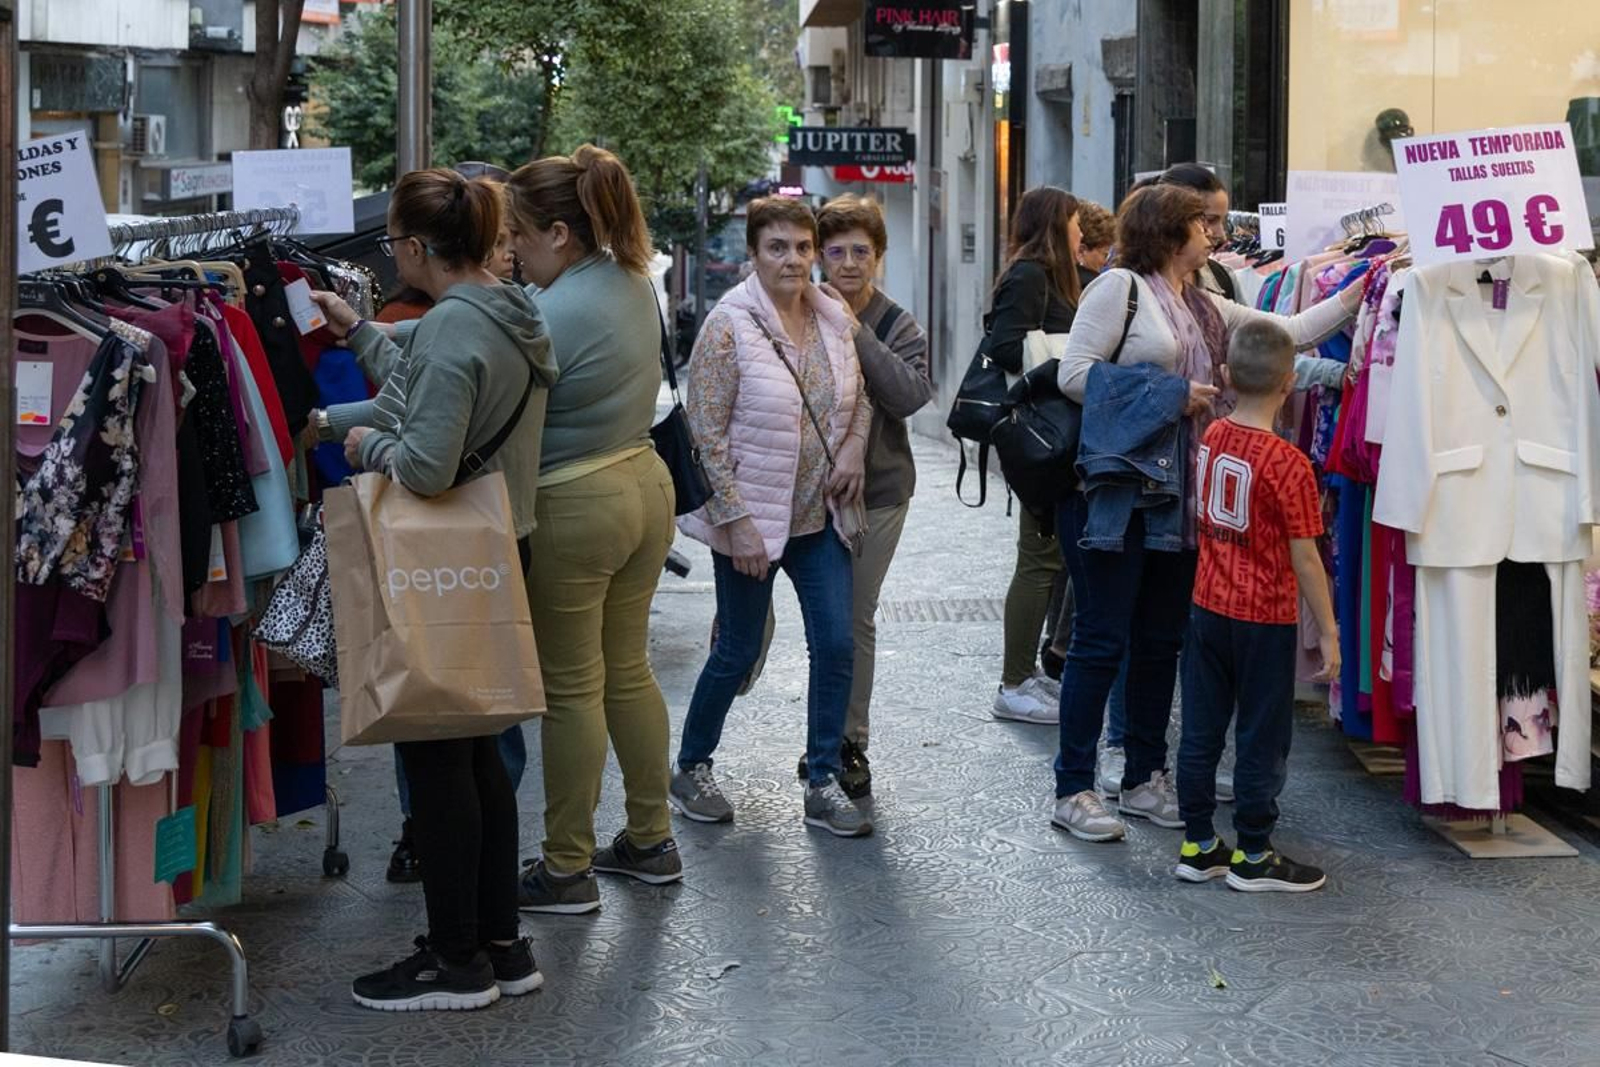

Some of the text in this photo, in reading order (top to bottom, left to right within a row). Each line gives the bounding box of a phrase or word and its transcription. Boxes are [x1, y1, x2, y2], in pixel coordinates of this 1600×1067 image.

[876, 7, 959, 26] PINK HAIR
[65, 137, 79, 151] Y
[791, 131, 903, 152] JUPITER
[1404, 130, 1565, 164] NUEVA TEMPORADA
[1448, 160, 1535, 182] TALLAS SUELTAS
[28, 198, 75, 258] €
[1435, 194, 1565, 254] 49 €
[1197, 443, 1252, 533] 10
